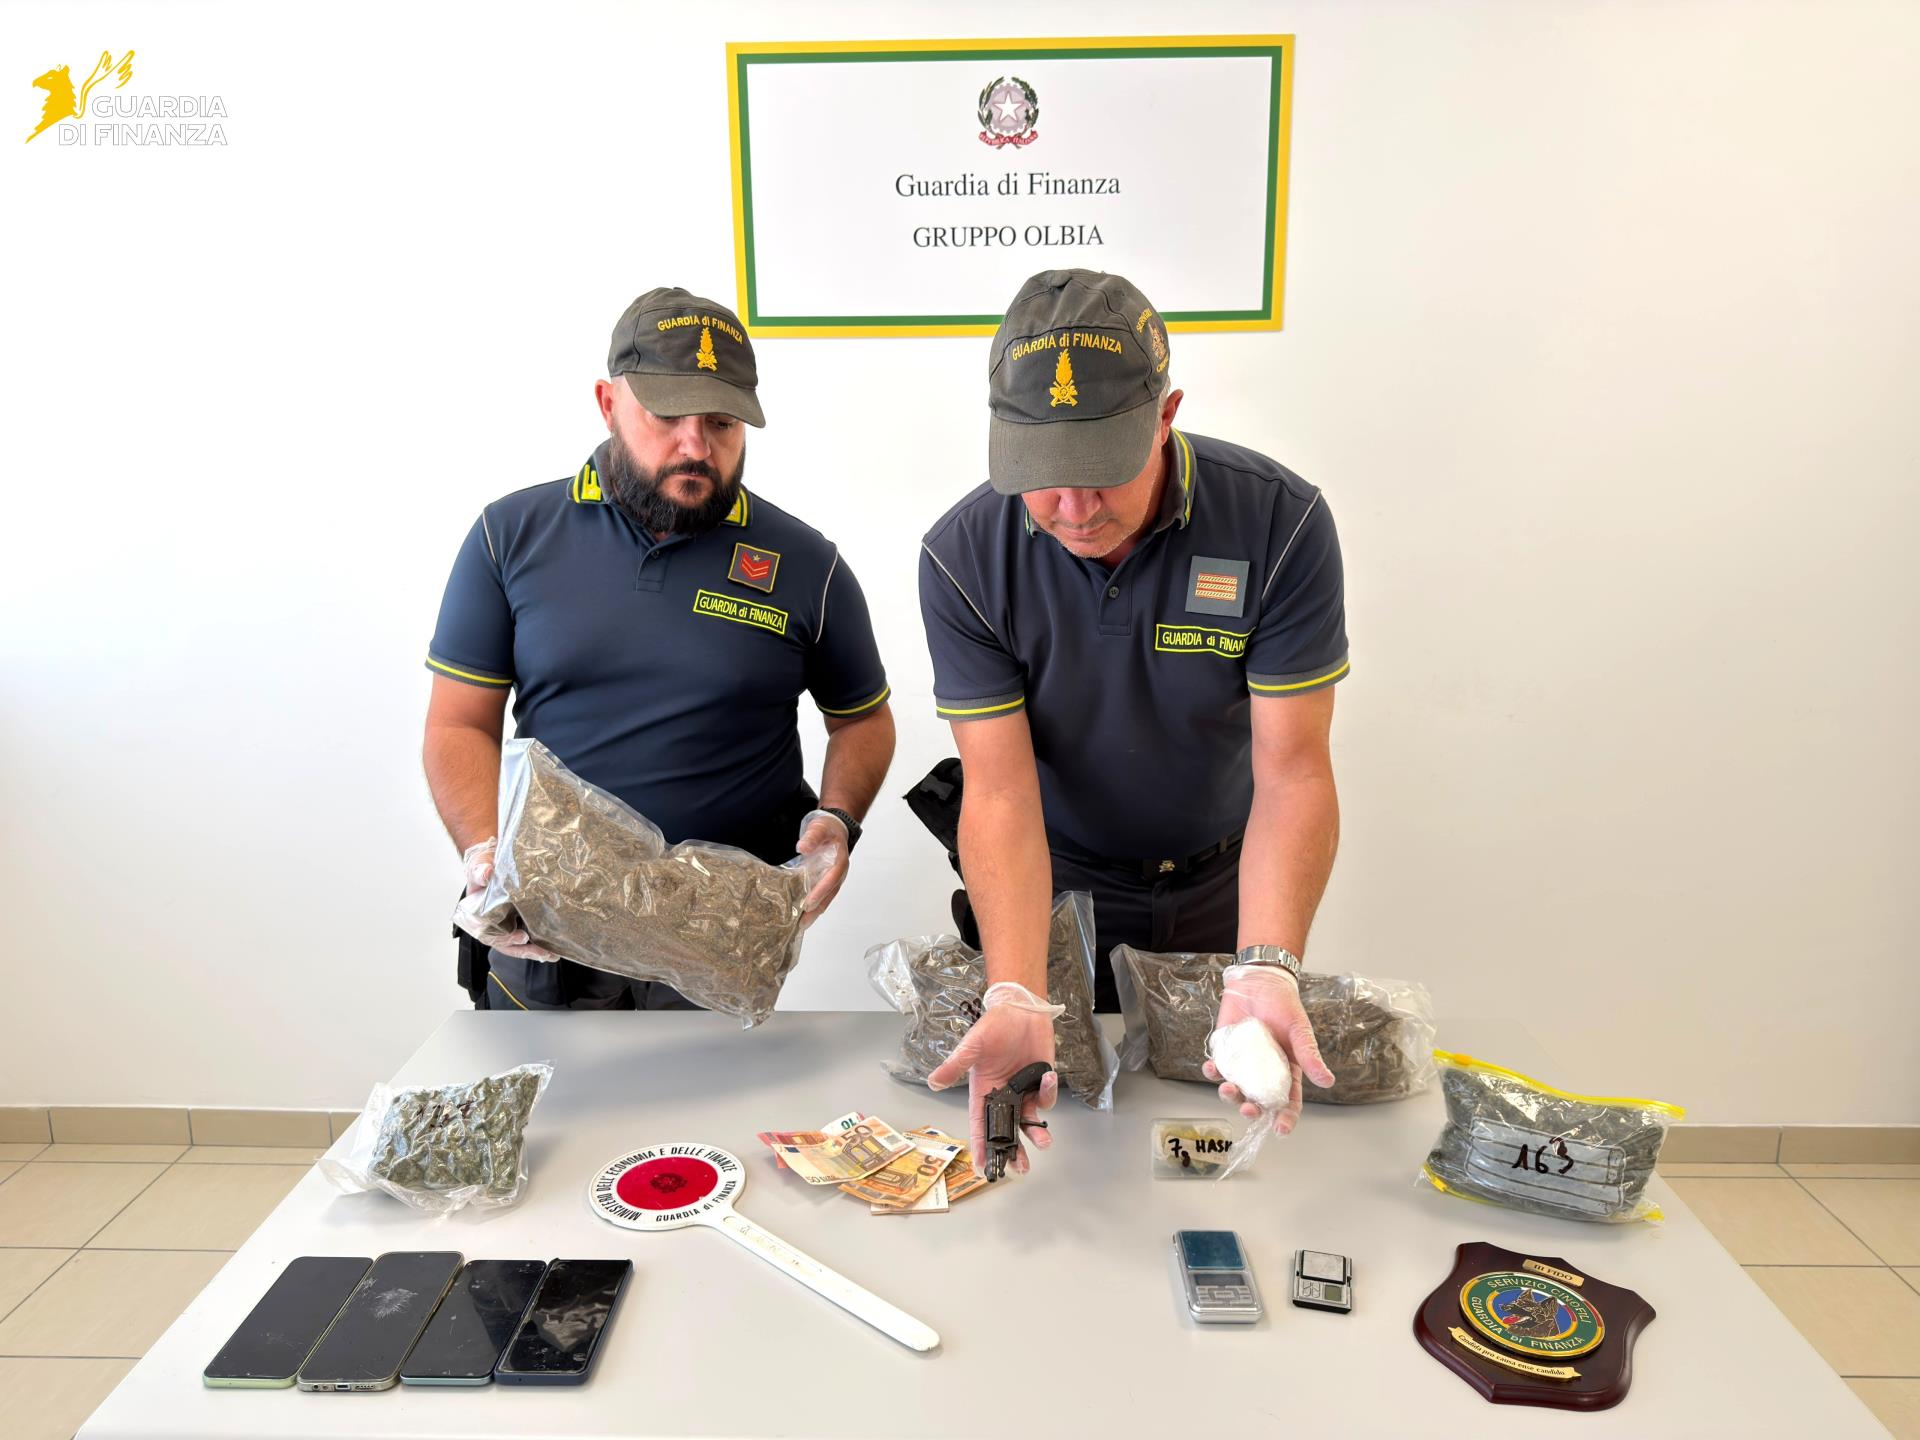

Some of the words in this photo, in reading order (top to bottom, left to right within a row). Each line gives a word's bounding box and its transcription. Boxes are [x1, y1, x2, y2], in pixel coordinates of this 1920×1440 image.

[895, 173, 989, 197] Guardia
[997, 173, 1018, 195] di
[1028, 172, 1121, 195] Finanza
[913, 226, 1017, 248] GRUPPO
[1024, 224, 1105, 246] OLBIA
[657, 315, 700, 331] GUARDIA
[701, 315, 710, 327] di
[711, 317, 743, 345] FINANZA
[1012, 335, 1056, 361] GUARDIA
[1059, 333, 1070, 348] di
[1073, 332, 1122, 354] FINANZA
[699, 596, 737, 616] GUARDIA
[738, 606, 748, 618] di
[749, 607, 783, 629] FINANZA
[1162, 631, 1202, 646] GUARDIA
[1206, 635, 1215, 647] di
[1219, 636, 1248, 652] FINAN
[841, 1117, 857, 1130] 10
[605, 1150, 656, 1176] ECONOMIA
[659, 1147, 666, 1156] E
[670, 1146, 705, 1156] DELLE
[703, 1150, 738, 1173] FINANZE
[1512, 1136, 1575, 1174] 163
[916, 1154, 946, 1177] 50
[597, 1193, 642, 1221] MINISTERO
[655, 1208, 701, 1222] GUARDIA
[711, 1180, 737, 1204] FINANZA
[1487, 1277, 1547, 1290] SERVIZIO
[1550, 1288, 1592, 1324] CINOFILI
[1471, 1296, 1504, 1335] GUARDIA
[1510, 1335, 1523, 1344] DI
[1530, 1336, 1586, 1351] FINANZA
